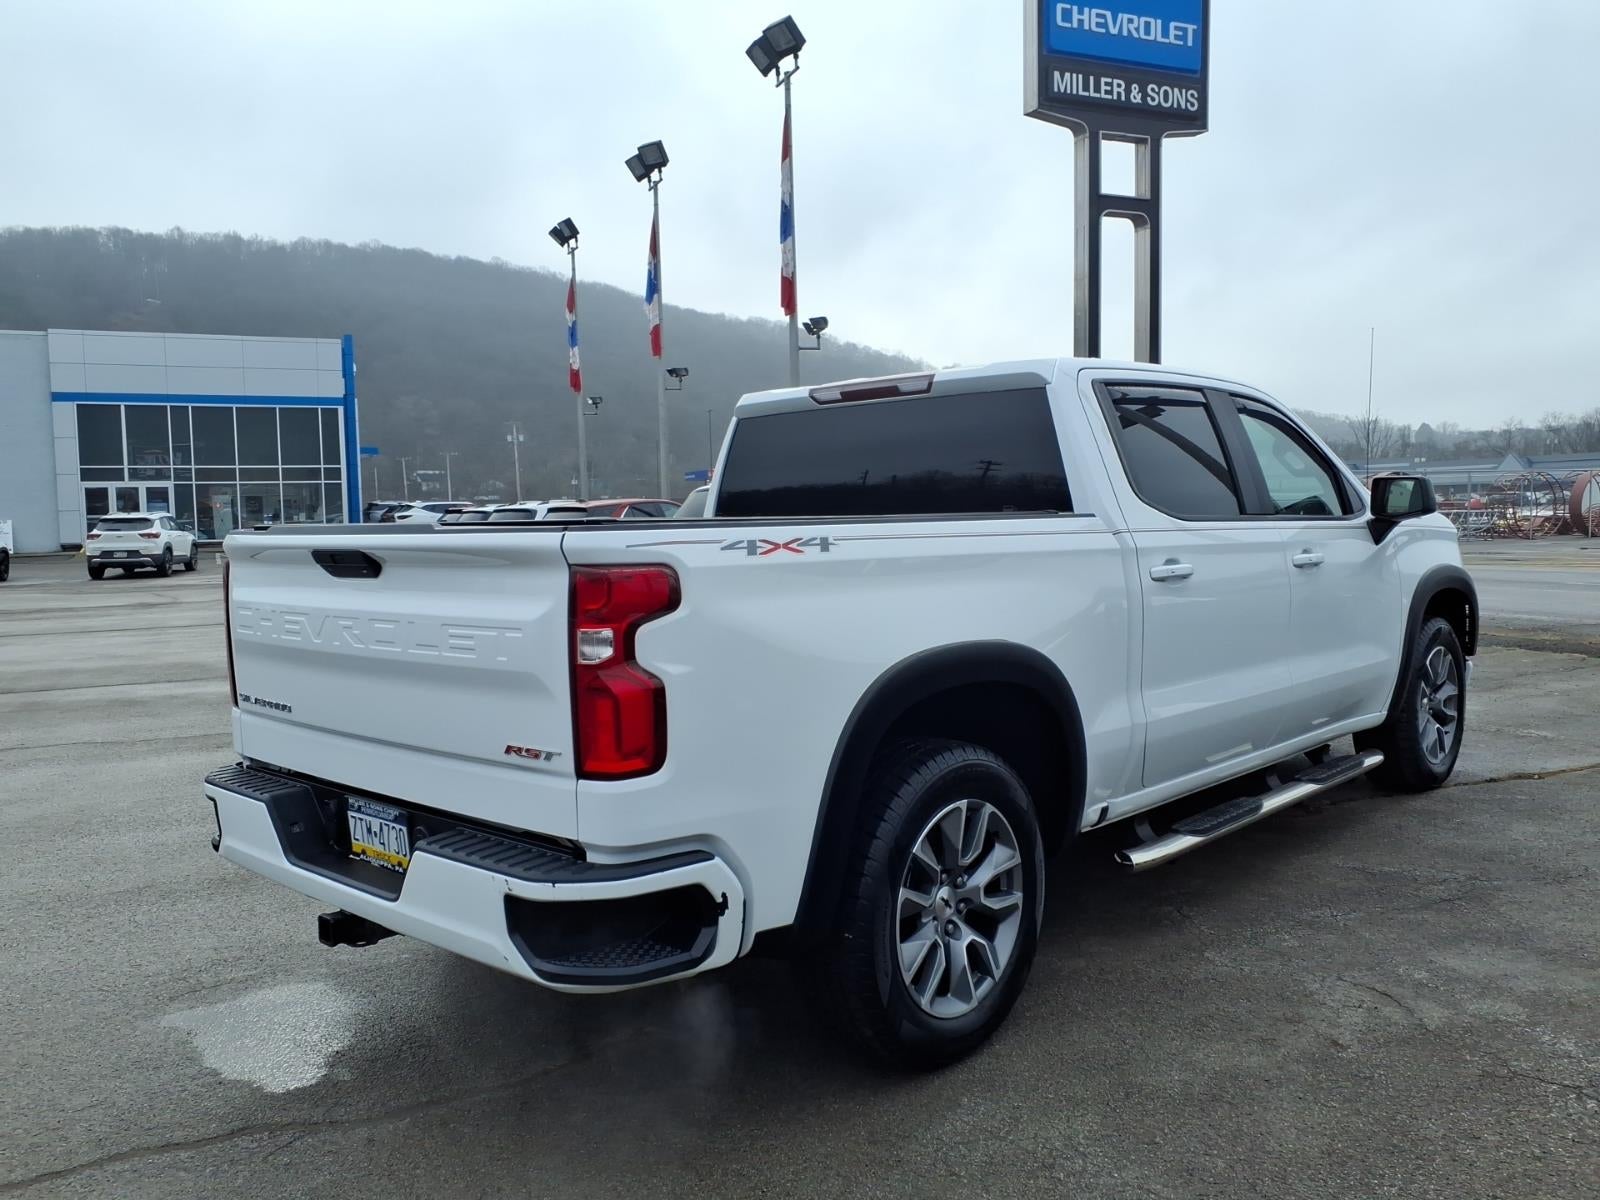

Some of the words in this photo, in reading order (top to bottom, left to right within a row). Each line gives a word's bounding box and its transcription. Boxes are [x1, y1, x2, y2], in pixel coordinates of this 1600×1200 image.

[1056, 3, 1197, 46] CHEVROLET
[1053, 70, 1126, 101] MILLER
[1130, 83, 1142, 104] &
[1147, 84, 1198, 111] SONS
[236, 606, 522, 661] CHEVROLET
[504, 744, 562, 762] RST
